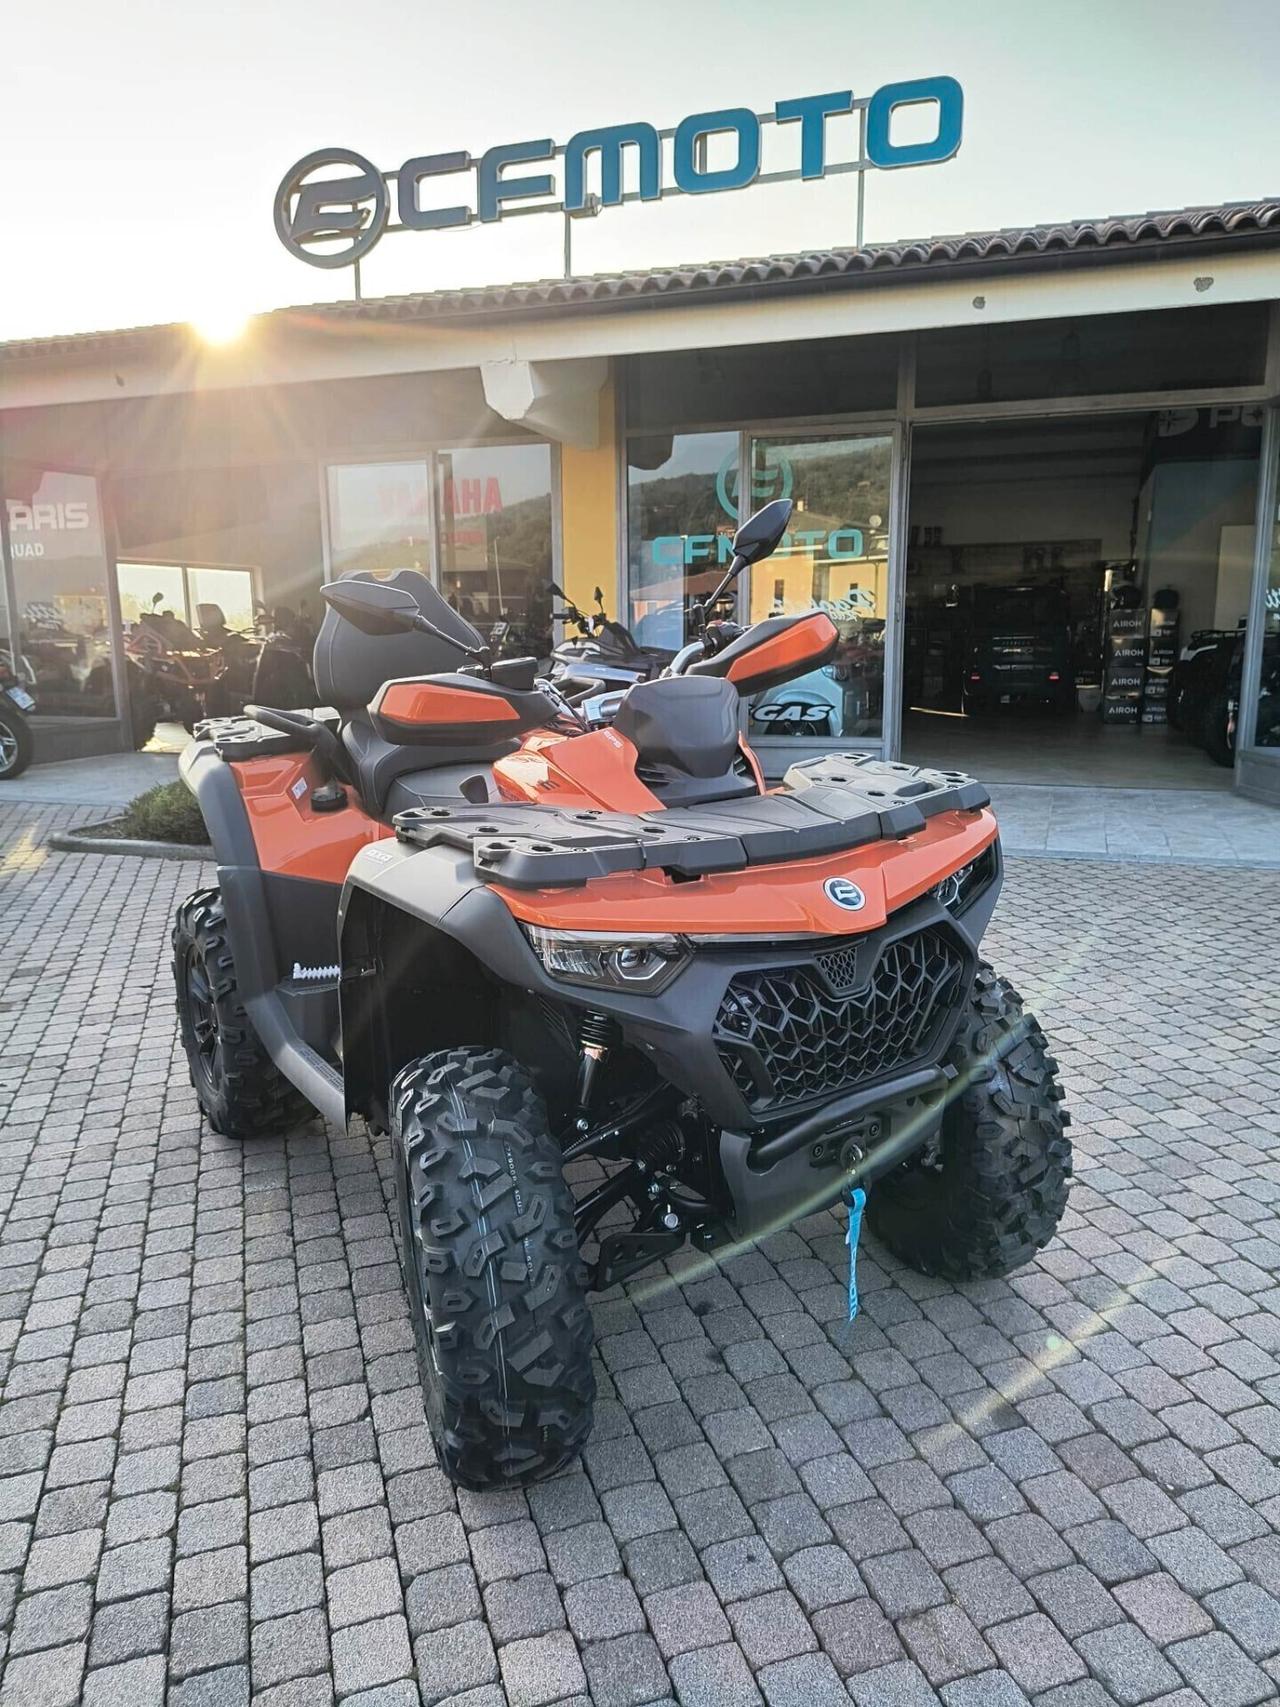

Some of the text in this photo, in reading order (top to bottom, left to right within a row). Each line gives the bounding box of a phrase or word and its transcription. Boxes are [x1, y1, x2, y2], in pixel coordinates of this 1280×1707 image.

[398, 75, 964, 230] CFMOTO
[378, 476, 503, 516] YAHA
[10, 542, 45, 558] UAD
[1113, 620, 1142, 628] AIROH
[1115, 649, 1144, 657] AIROH
[1111, 678, 1140, 686] AIROH
[1108, 707, 1138, 715] AIROH
